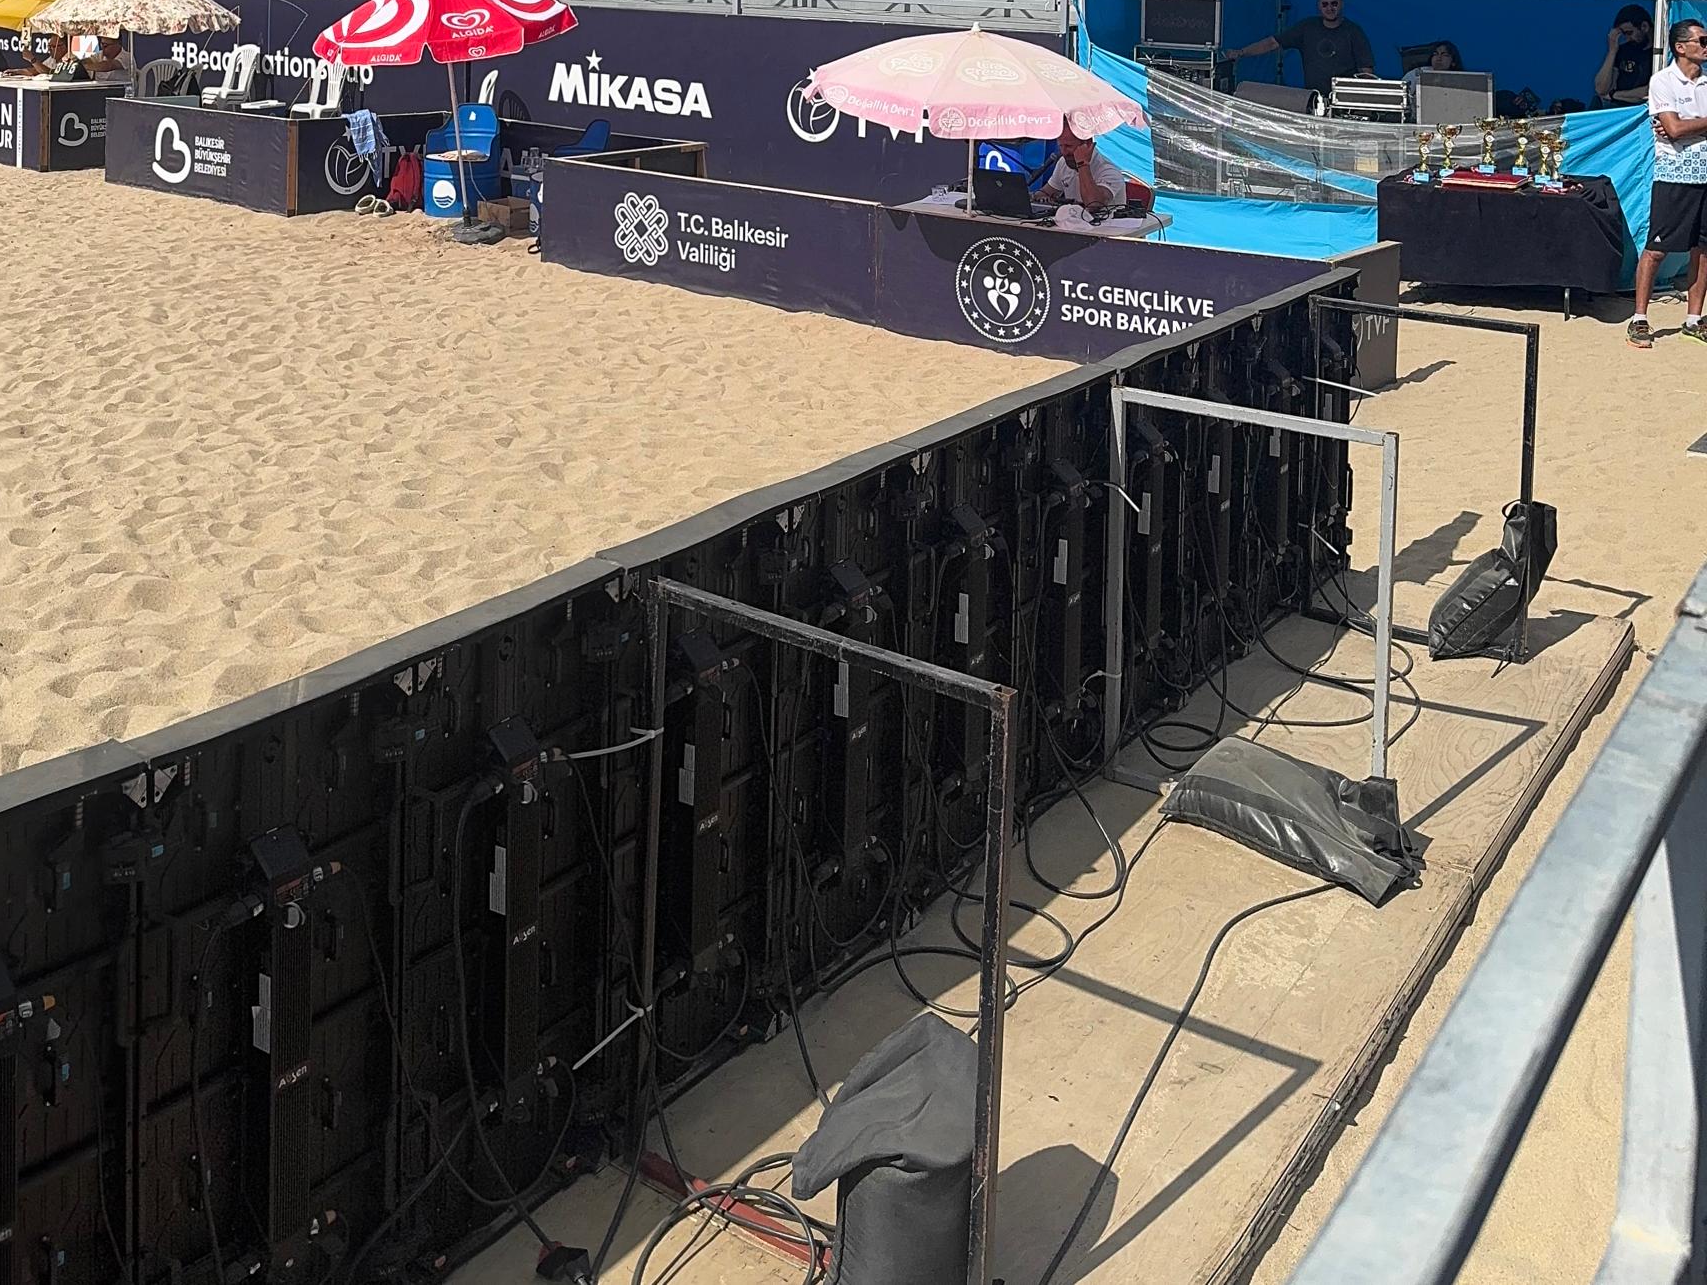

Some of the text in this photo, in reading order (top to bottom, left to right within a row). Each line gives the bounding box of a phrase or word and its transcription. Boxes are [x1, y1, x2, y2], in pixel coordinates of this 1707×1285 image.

[451, 25, 491, 39] ALGIDA
[370, 53, 401, 63] ALGIDA
[847, 95, 889, 115] Doğallık
[967, 113, 1017, 129] Doğallık
[1018, 113, 1051, 125] Devri
[194, 135, 225, 150] BALIKESİR
[194, 148, 231, 164] BÜYÜKŞEHİR
[194, 162, 227, 177] BELEDİYESİ
[677, 211, 789, 249] T.C. Balıkesir
[676, 240, 736, 272] Valiliği
[1060, 279, 1214, 318] T.C. GENÇLİK VE
[1060, 304, 1112, 328] SPOR
